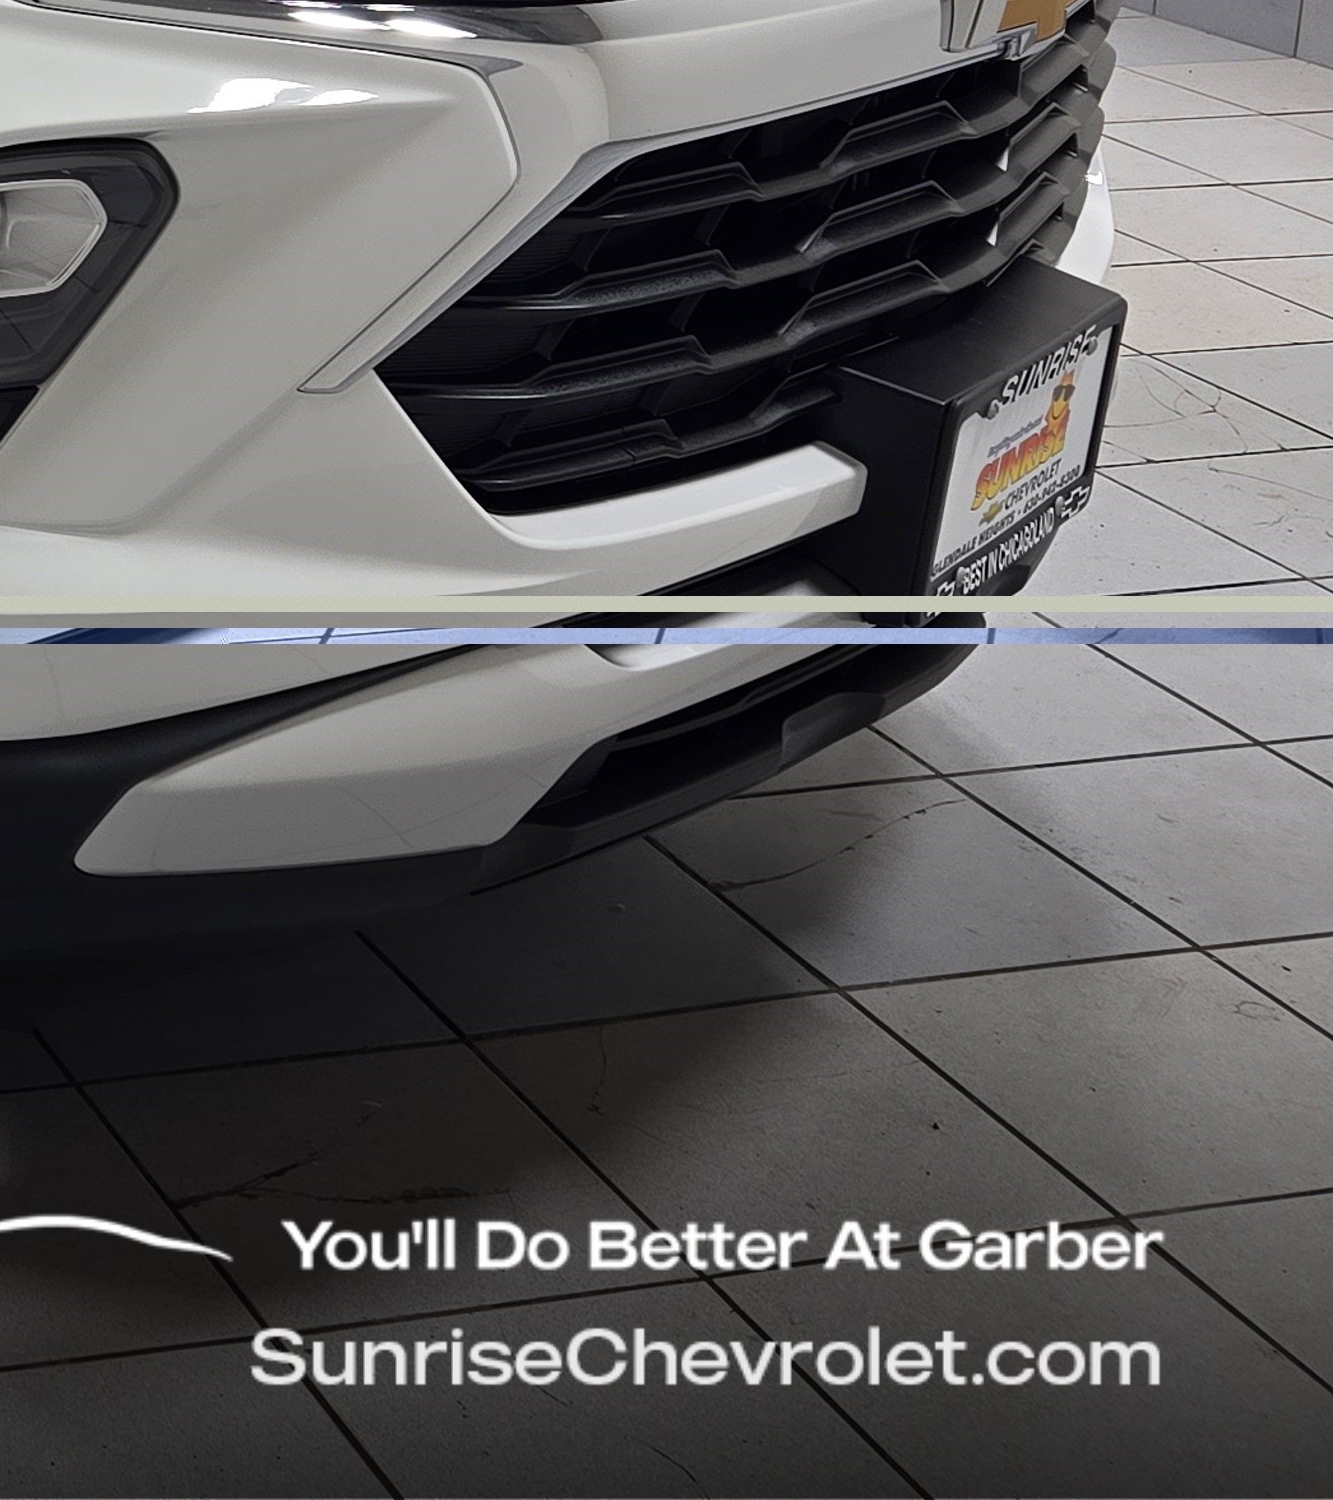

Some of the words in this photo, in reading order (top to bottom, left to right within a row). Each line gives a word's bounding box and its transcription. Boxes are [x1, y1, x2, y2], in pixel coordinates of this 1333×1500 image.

[1000, 323, 1098, 407] SUNRISE
[970, 410, 1070, 512] SUNRISE
[1004, 457, 1062, 510] CHEVROLET
[963, 555, 988, 595] BEST
